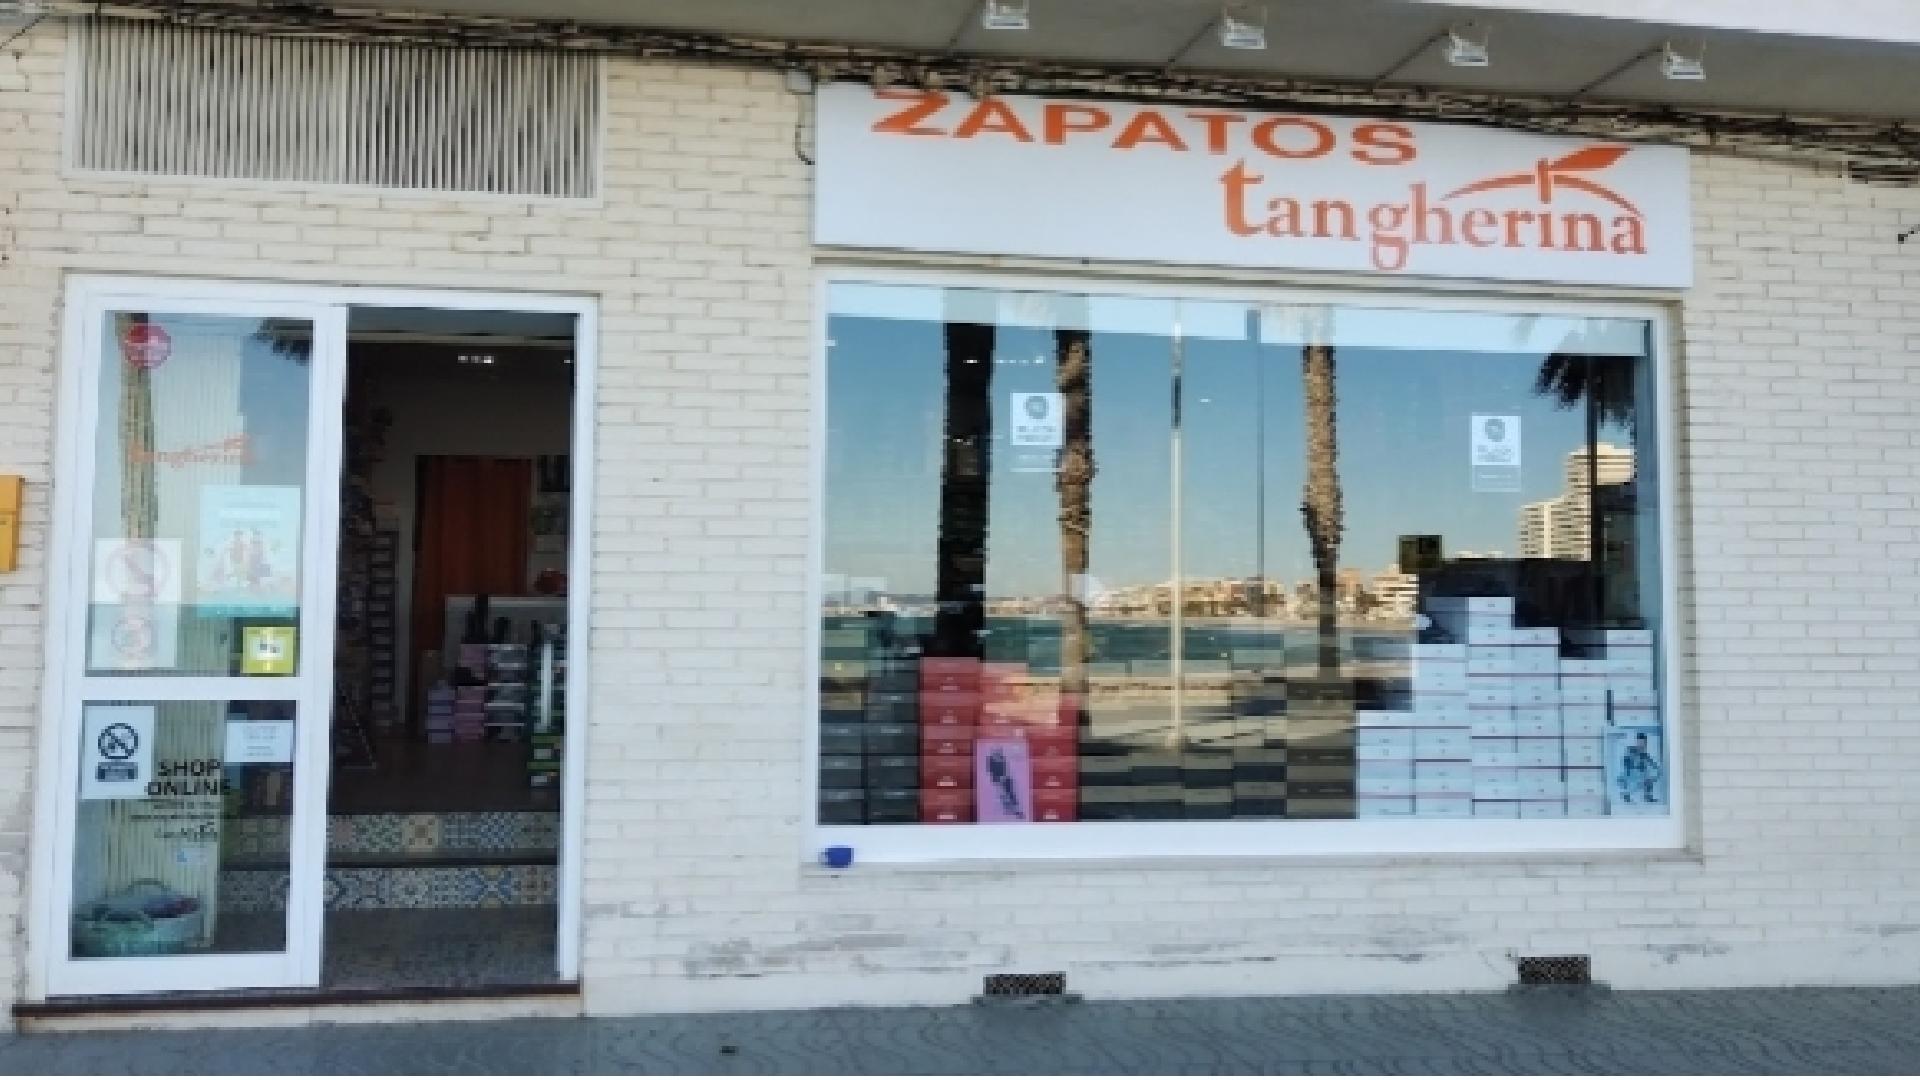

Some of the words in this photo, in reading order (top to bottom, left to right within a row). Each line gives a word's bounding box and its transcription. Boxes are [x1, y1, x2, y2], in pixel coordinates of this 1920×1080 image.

[871, 89, 1417, 165] ZAPATOS
[1219, 158, 1647, 271] tangherina
[147, 778, 231, 796] ONLINE
[158, 758, 221, 776] SHOP
